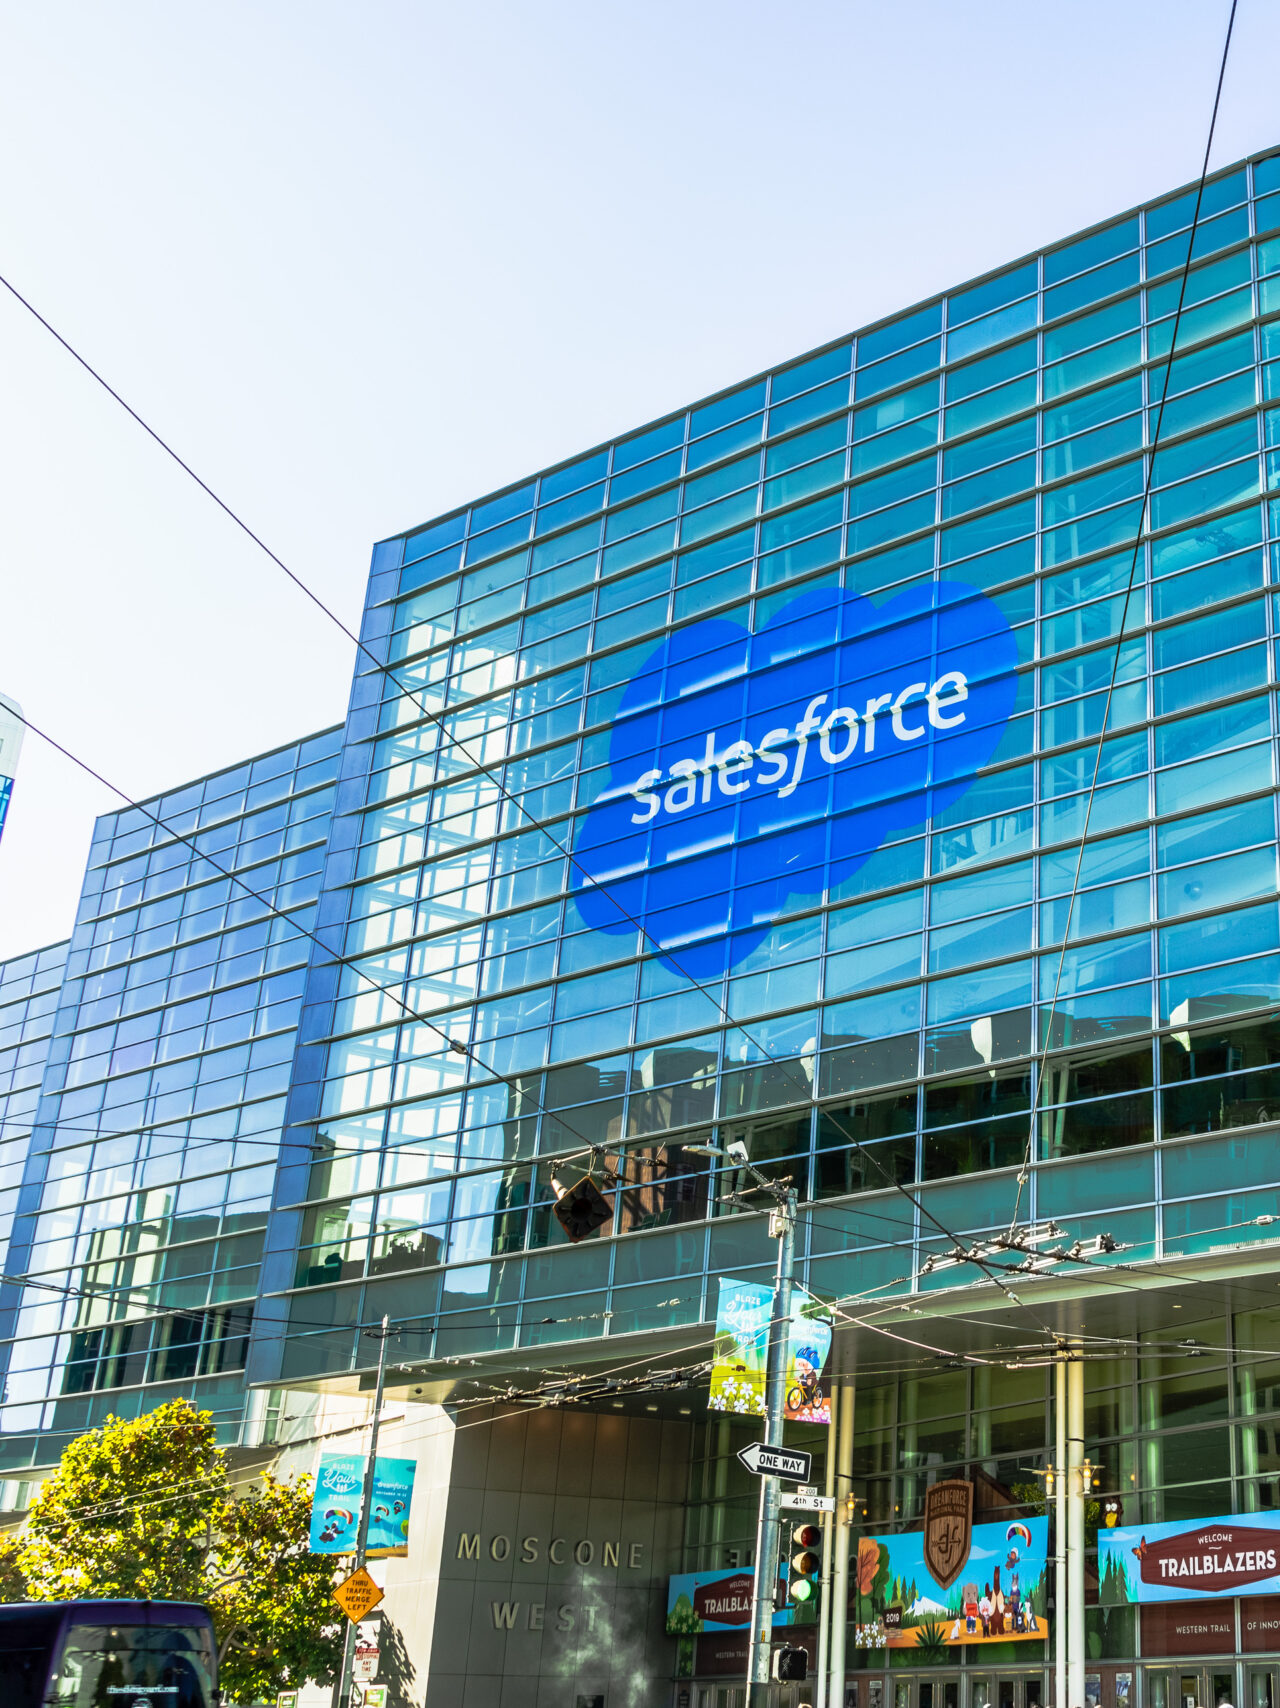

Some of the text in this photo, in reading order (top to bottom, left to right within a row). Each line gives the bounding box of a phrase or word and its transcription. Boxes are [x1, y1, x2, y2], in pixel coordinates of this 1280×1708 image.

[631, 671, 968, 825] salesforce
[735, 1294, 761, 1304] BLAZE
[759, 1454, 802, 1472] ONE WAY
[322, 1467, 357, 1491] Your
[792, 1497, 823, 1508] 4th St
[1198, 1533, 1233, 1545] WELCOME
[457, 1533, 644, 1569] MOSCONE
[1159, 1549, 1277, 1578] TRAILBLAZERS
[346, 1587, 372, 1595] TRAFFIC
[729, 1581, 751, 1589] WELCOME
[491, 1602, 600, 1632] WEST
[886, 1613, 899, 1623] 2019
[1176, 1625, 1208, 1634] WESTERN
[1210, 1624, 1231, 1633] TRAIL
[1247, 1621, 1257, 1631] OF
